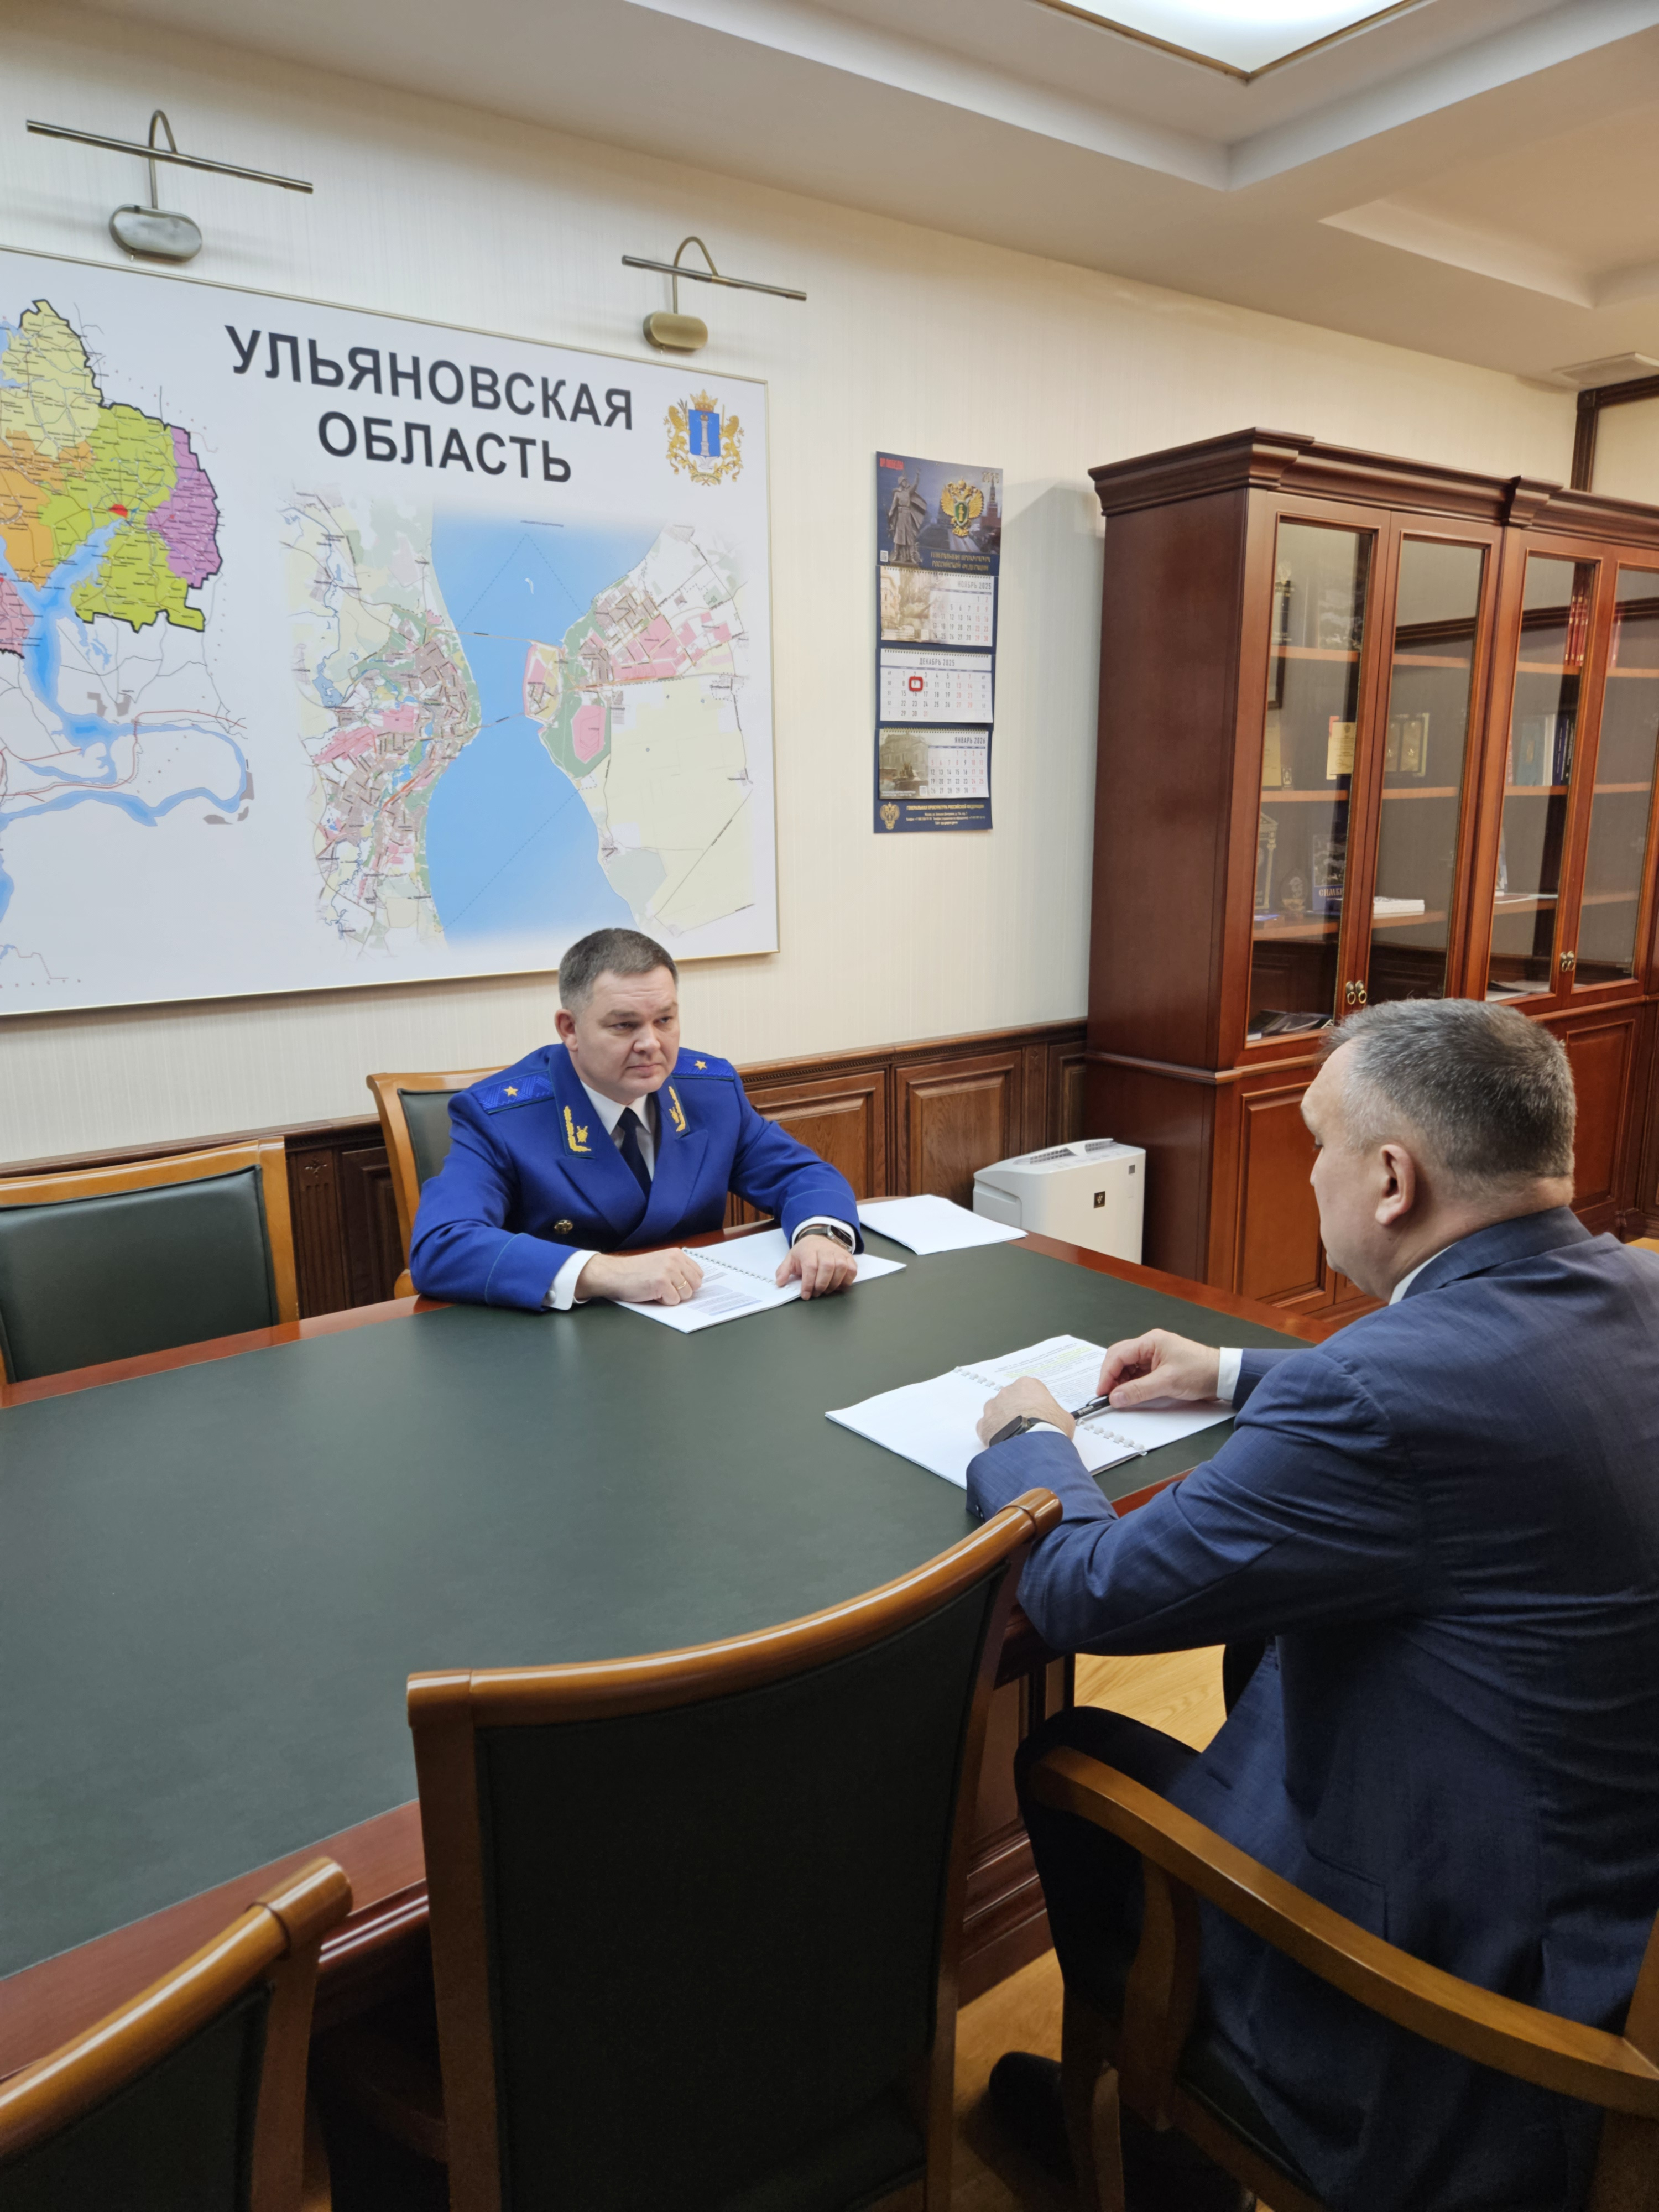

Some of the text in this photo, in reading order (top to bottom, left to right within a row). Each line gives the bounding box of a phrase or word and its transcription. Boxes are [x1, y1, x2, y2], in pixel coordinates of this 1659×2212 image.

[225, 325, 633, 430] УЛЬЯНОВСКАЯ
[318, 411, 572, 483] ОБЛАСТЬ
[957, 581, 977, 589] НОЯБРЬ
[919, 658, 941, 666] ДЕКАБРЬ
